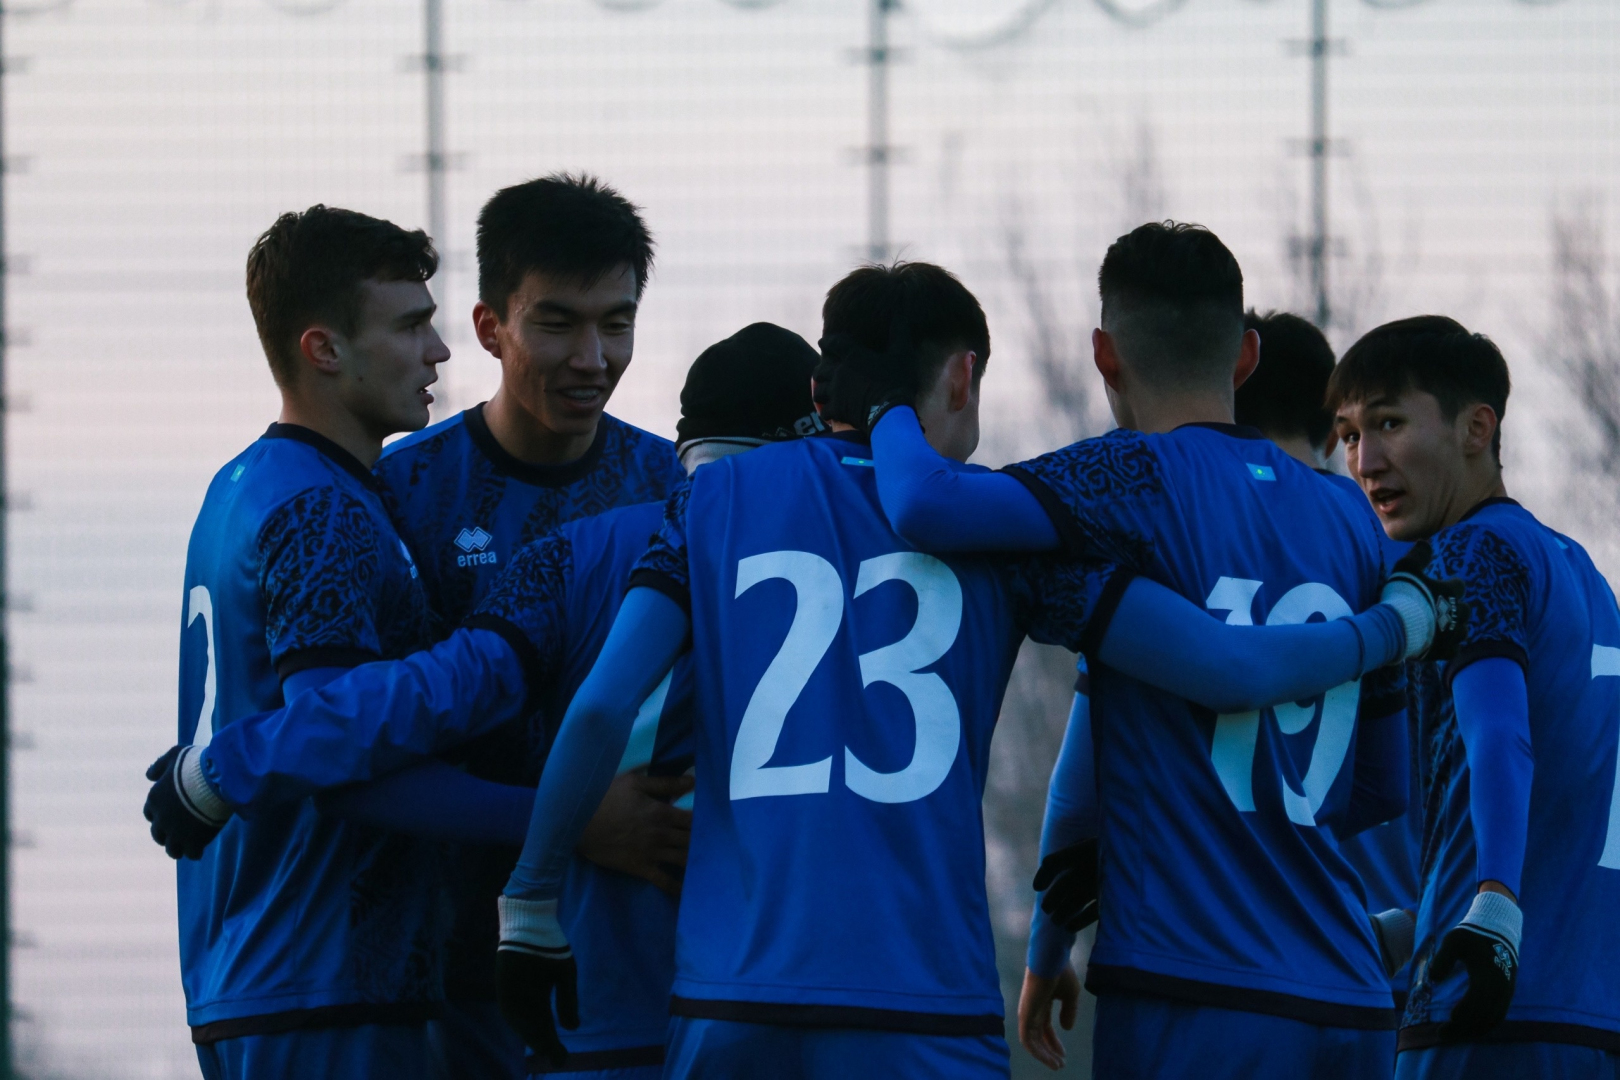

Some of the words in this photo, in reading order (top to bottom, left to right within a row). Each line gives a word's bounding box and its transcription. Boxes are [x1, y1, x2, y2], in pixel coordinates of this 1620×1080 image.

[456, 551, 498, 568] errea
[730, 550, 963, 804] 23
[1205, 576, 1362, 827] 19
